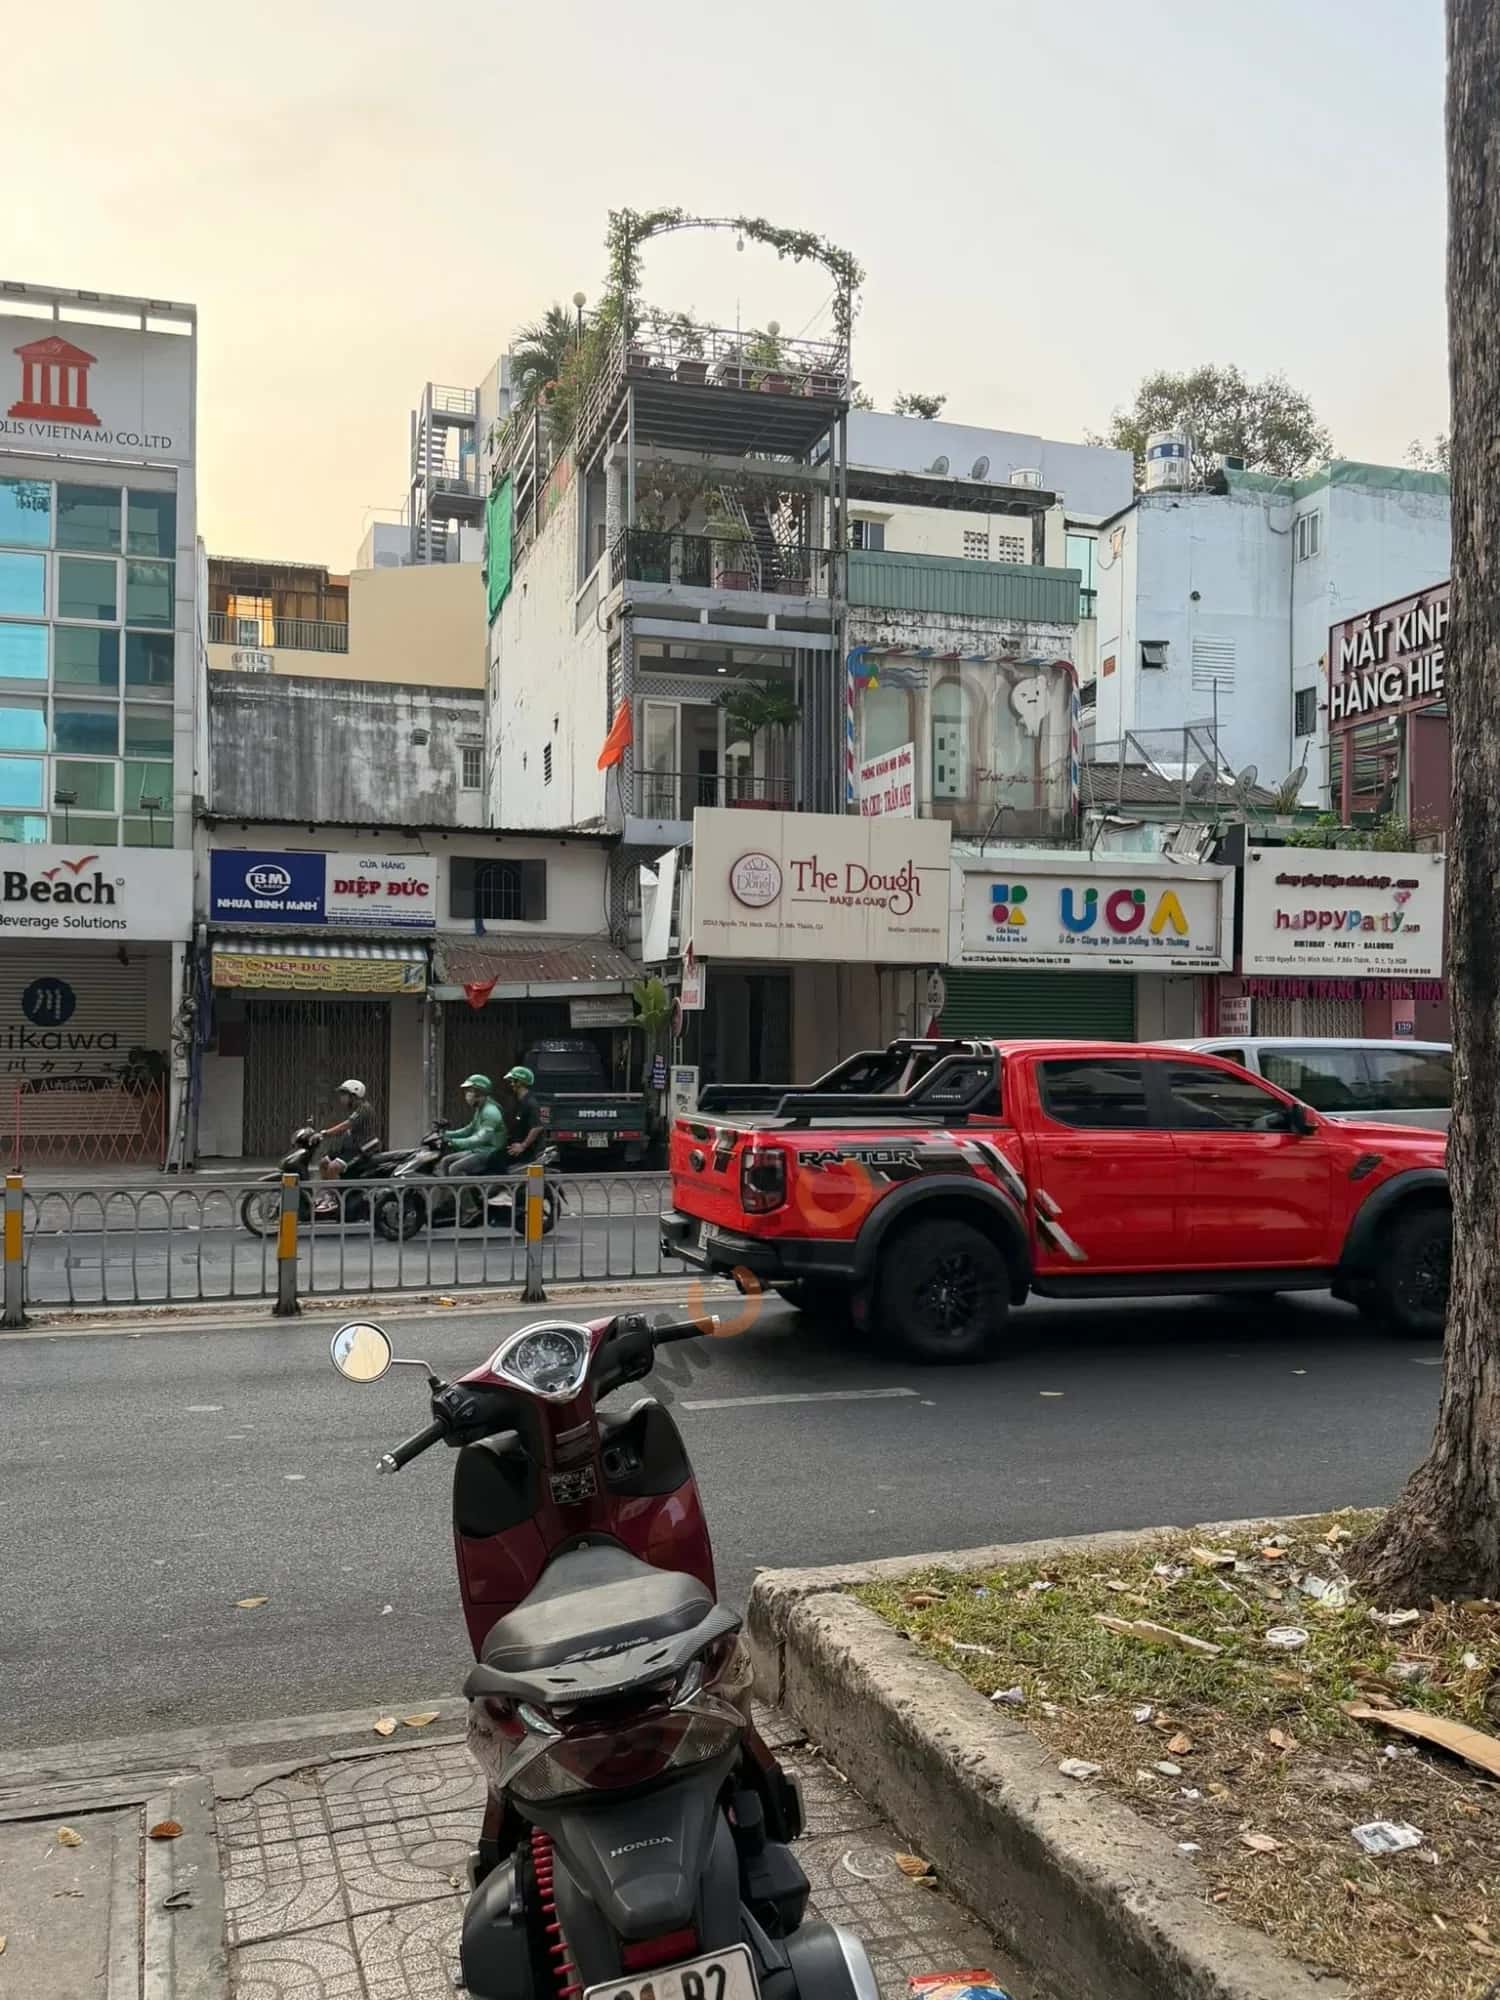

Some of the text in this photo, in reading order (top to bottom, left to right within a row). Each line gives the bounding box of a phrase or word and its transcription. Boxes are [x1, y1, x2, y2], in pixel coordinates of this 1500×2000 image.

[29, 423, 113, 444] (VIETNAM)
[1340, 614, 1389, 672] MẮT
[1331, 644, 1445, 721] HÀNG HIỆ
[3, 871, 115, 905] Beach
[334, 876, 429, 898] DIỆP ĐỨC
[790, 855, 921, 916] The Dough
[63, 915, 127, 929] Solutions
[1334, 941, 1355, 949] PARTY
[799, 1150, 922, 1171] RAPTOR
[609, 1836, 674, 1858] HONDA
